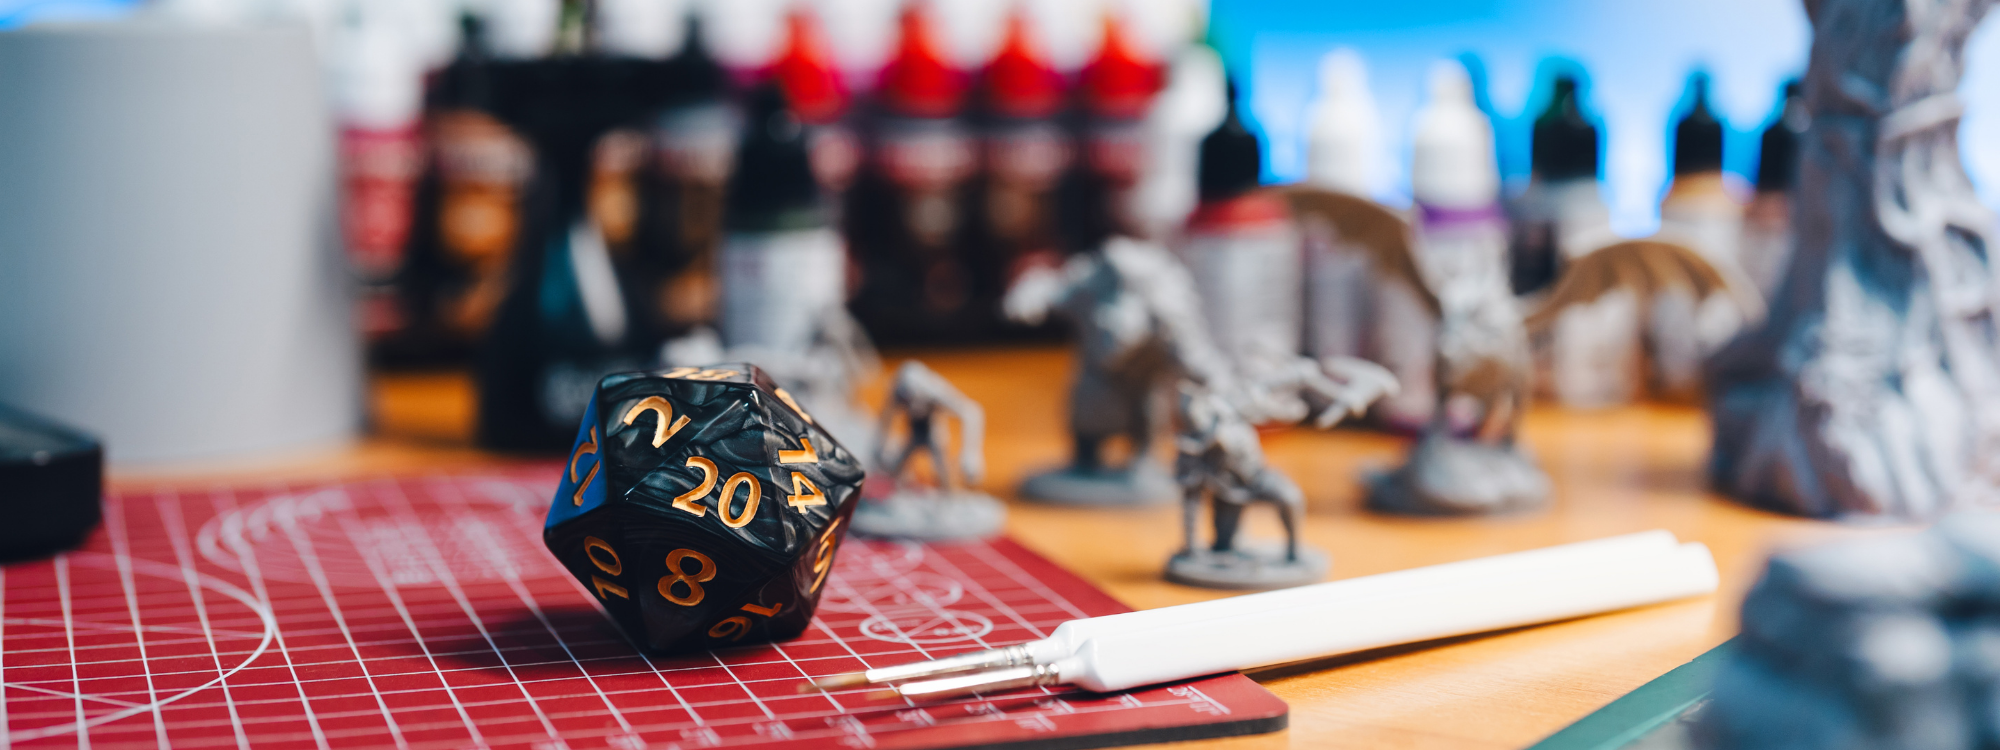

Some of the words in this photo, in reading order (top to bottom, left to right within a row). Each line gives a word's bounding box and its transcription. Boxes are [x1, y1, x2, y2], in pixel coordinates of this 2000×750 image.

[623, 395, 691, 449] 2
[672, 456, 761, 528] 20
[778, 438, 827, 513] 14
[584, 535, 629, 601] 10
[658, 548, 717, 607] 8
[708, 602, 783, 641] 16
